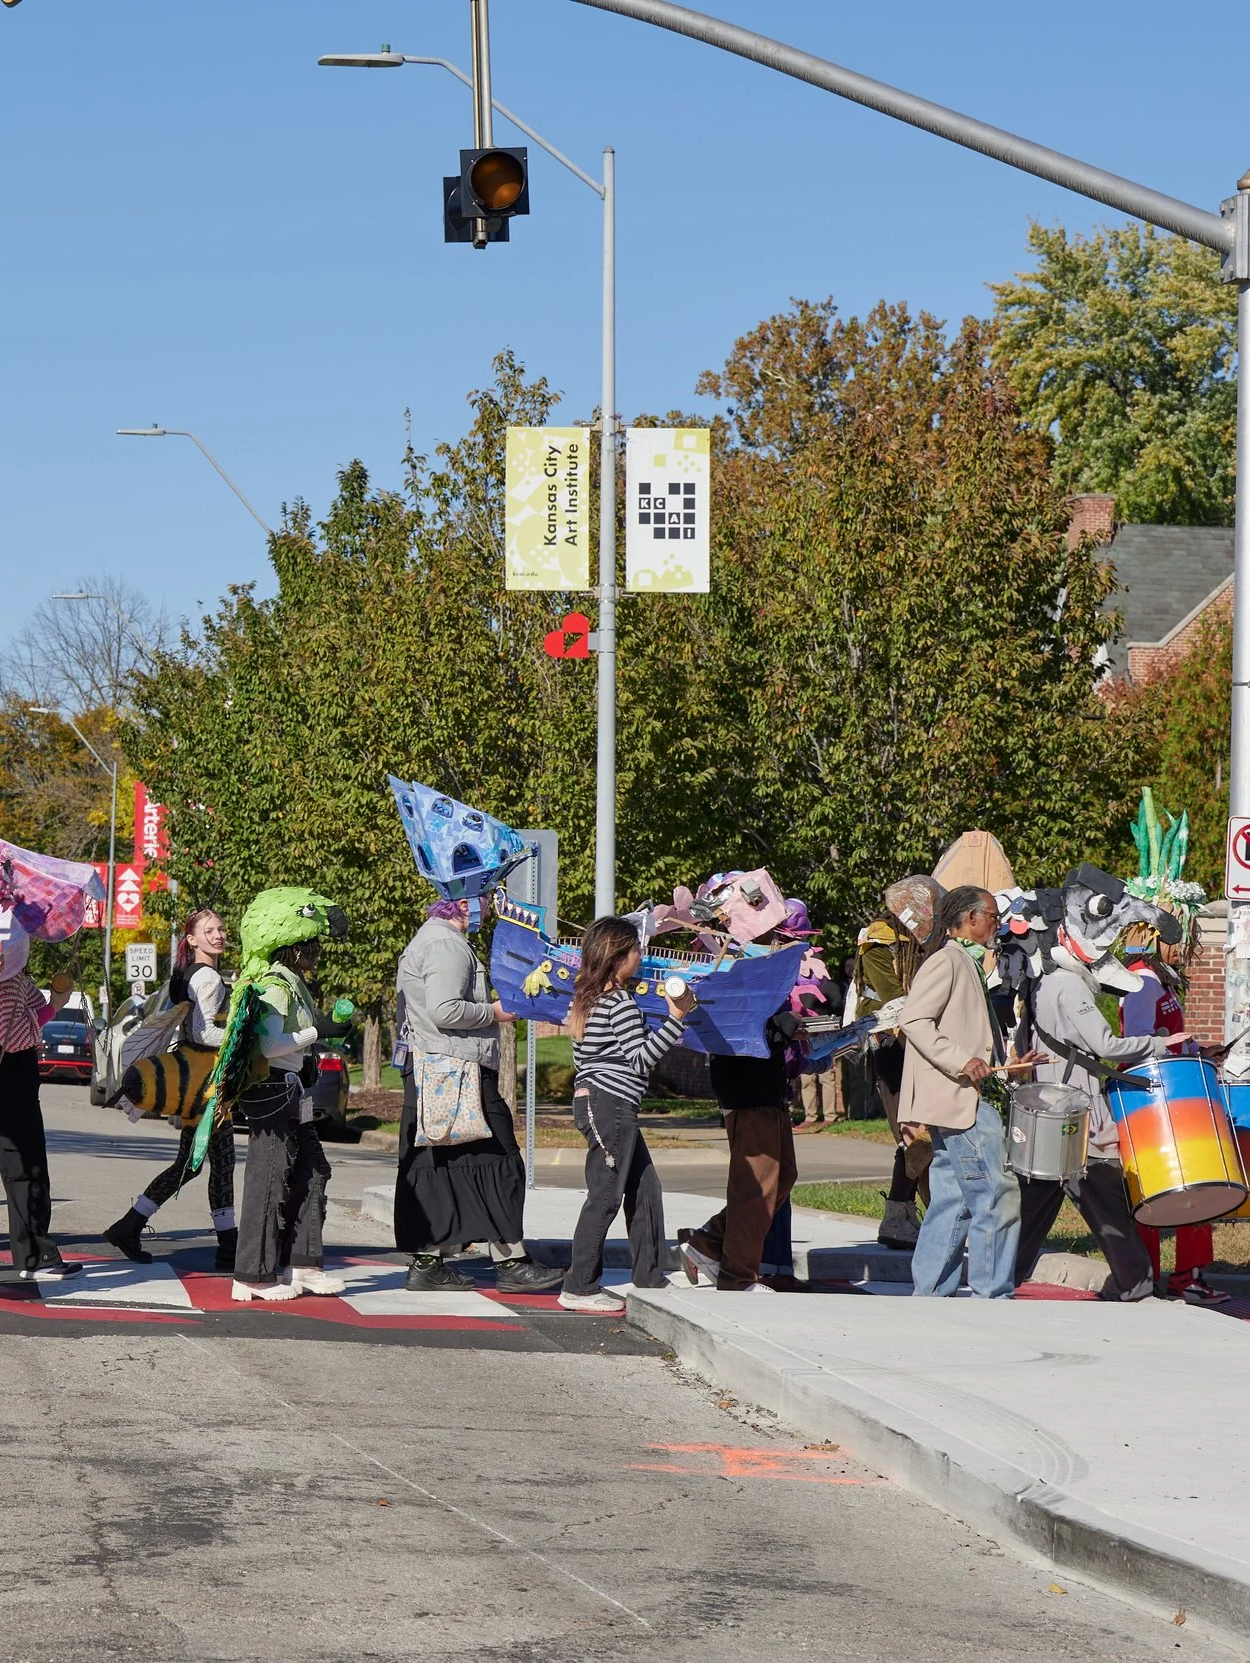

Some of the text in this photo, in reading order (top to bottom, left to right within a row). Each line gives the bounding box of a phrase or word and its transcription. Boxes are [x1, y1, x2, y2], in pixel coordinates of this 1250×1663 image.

[543, 445, 562, 546] Kansas City
[564, 443, 579, 546] Art Institute
[131, 965, 153, 978] 30
